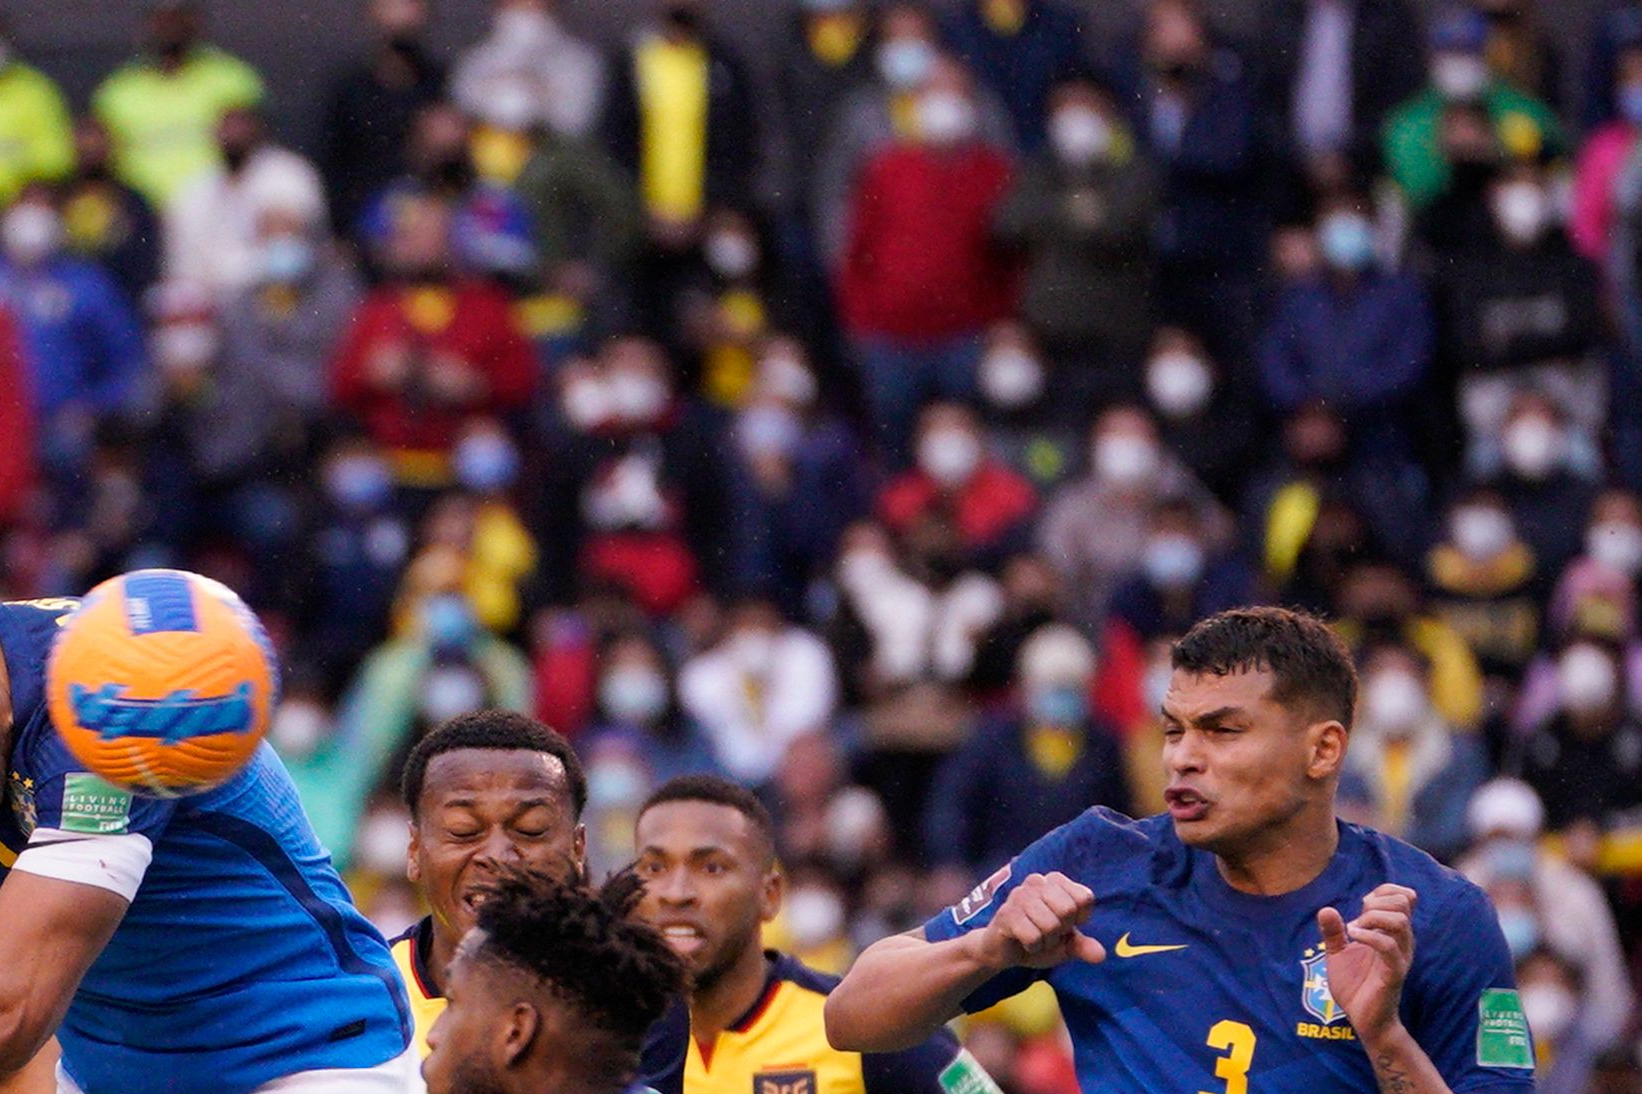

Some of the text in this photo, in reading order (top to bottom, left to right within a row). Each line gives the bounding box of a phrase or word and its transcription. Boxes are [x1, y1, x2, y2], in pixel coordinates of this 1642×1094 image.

[69, 795, 127, 805] LIVING
[68, 804, 125, 814] FOOTBALL
[1296, 1022, 1356, 1040] BRASIL
